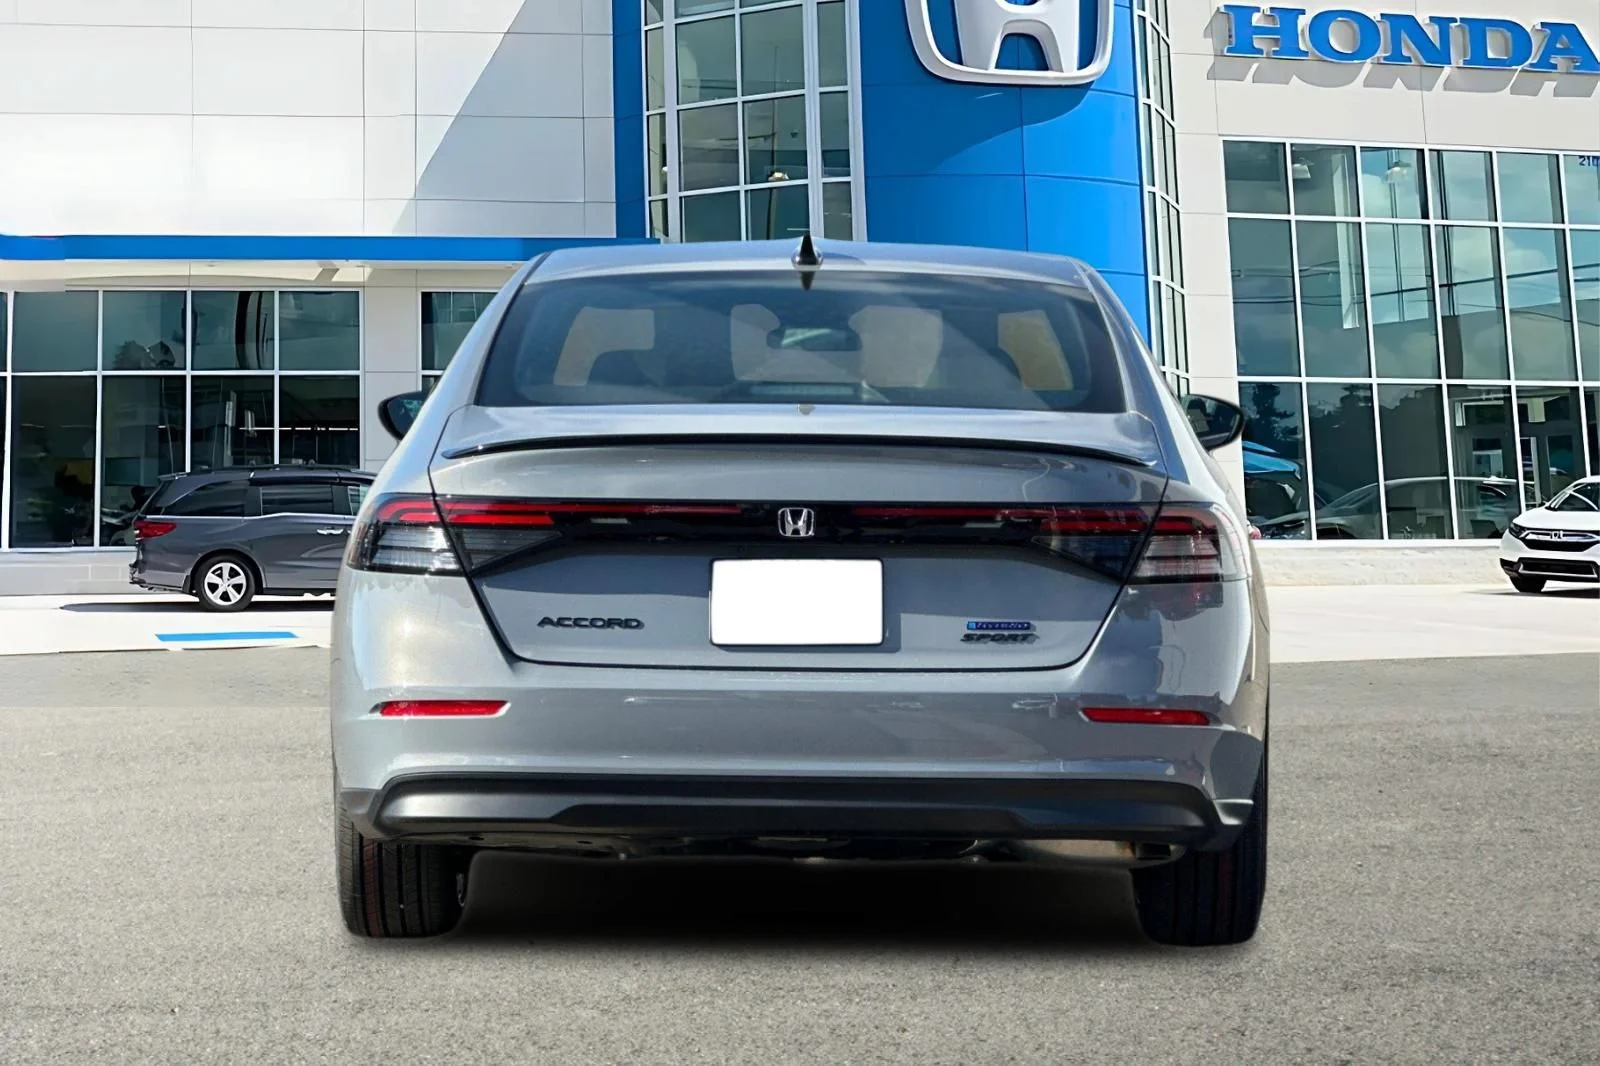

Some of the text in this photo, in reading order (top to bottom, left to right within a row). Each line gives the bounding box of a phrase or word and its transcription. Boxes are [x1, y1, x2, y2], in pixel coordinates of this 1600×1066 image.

[1222, 4, 1600, 73] HONDA
[537, 616, 644, 629] ACCORD
[960, 633, 1037, 643] SPORT
